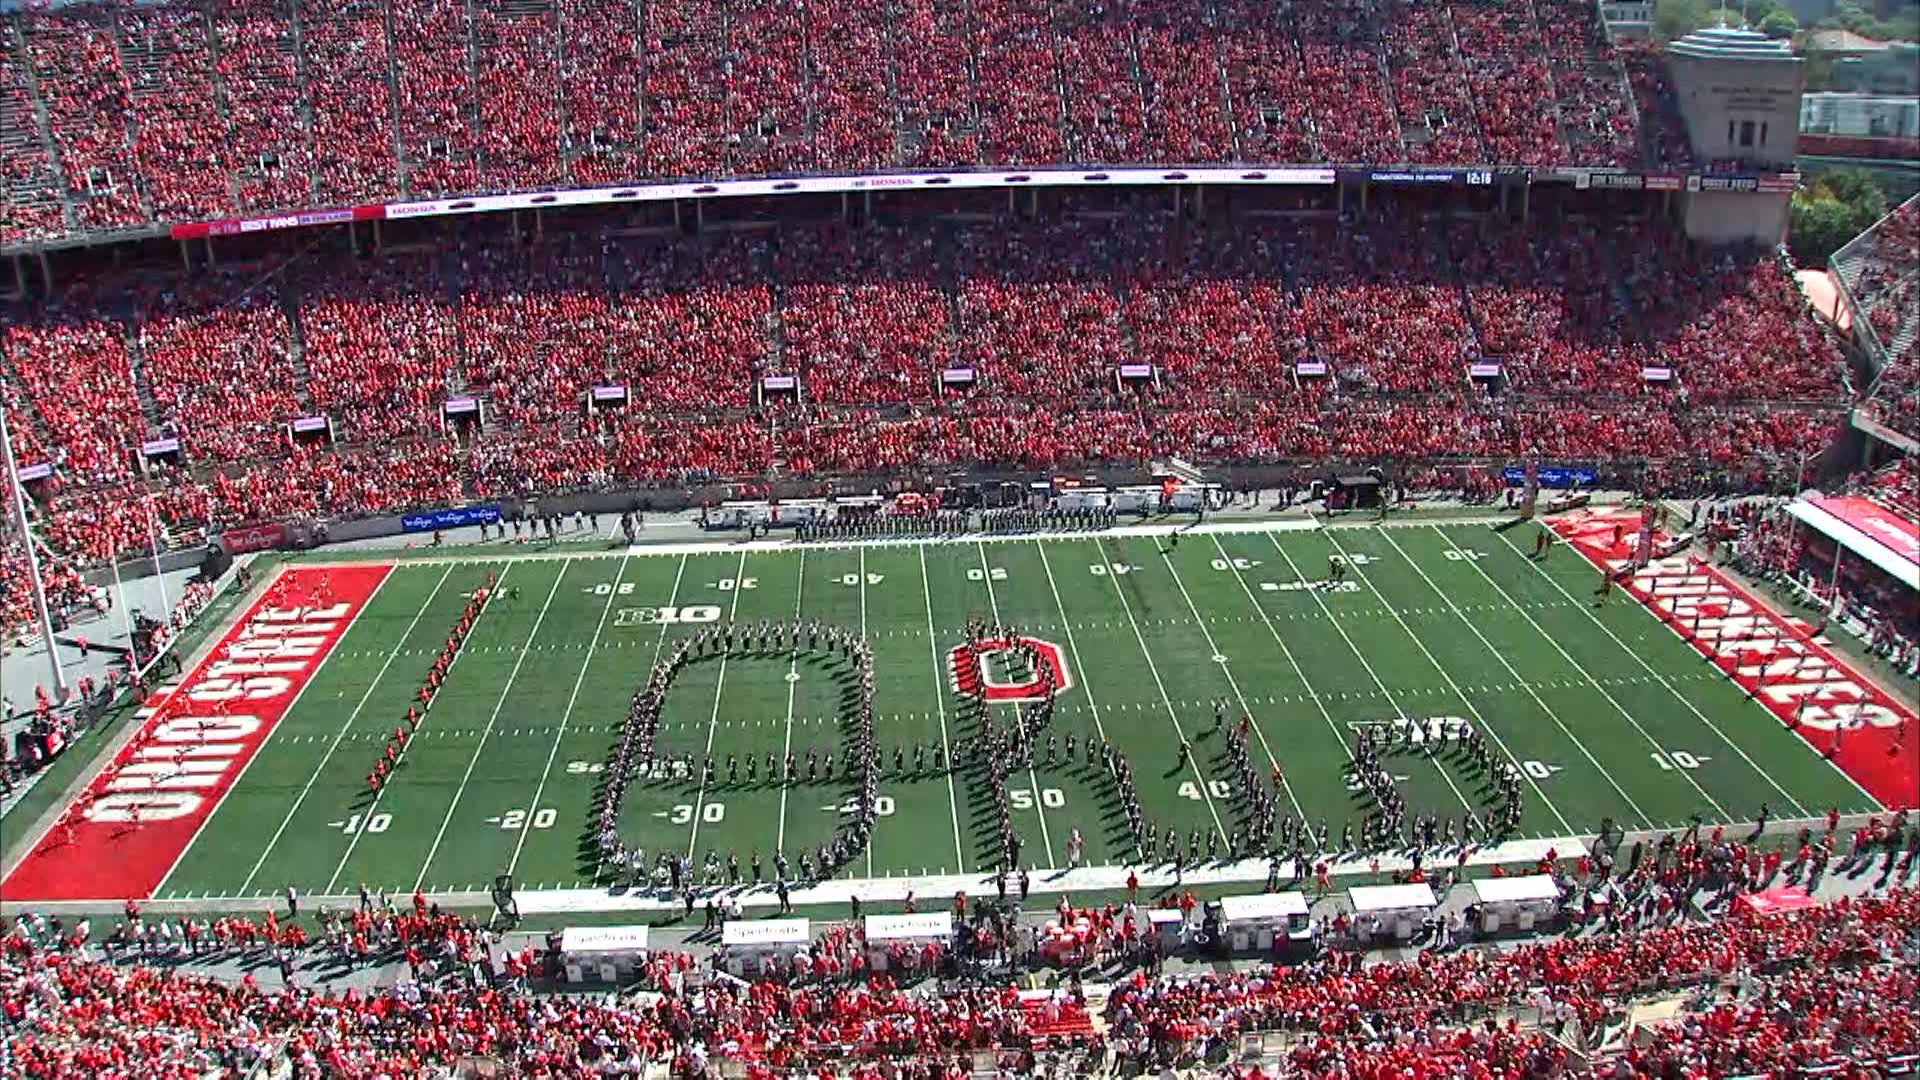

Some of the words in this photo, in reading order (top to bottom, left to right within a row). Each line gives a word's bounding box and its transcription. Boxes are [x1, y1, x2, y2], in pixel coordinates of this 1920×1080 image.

[392, 204, 437, 215] HONDA
[82, 714, 264, 823] OHIO
[187, 602, 352, 700] STATE
[1650, 751, 1700, 770] 10
[1010, 789, 1065, 809] 50
[500, 808, 558, 829] 20
[671, 803, 725, 823] 30
[343, 813, 393, 834] 10
